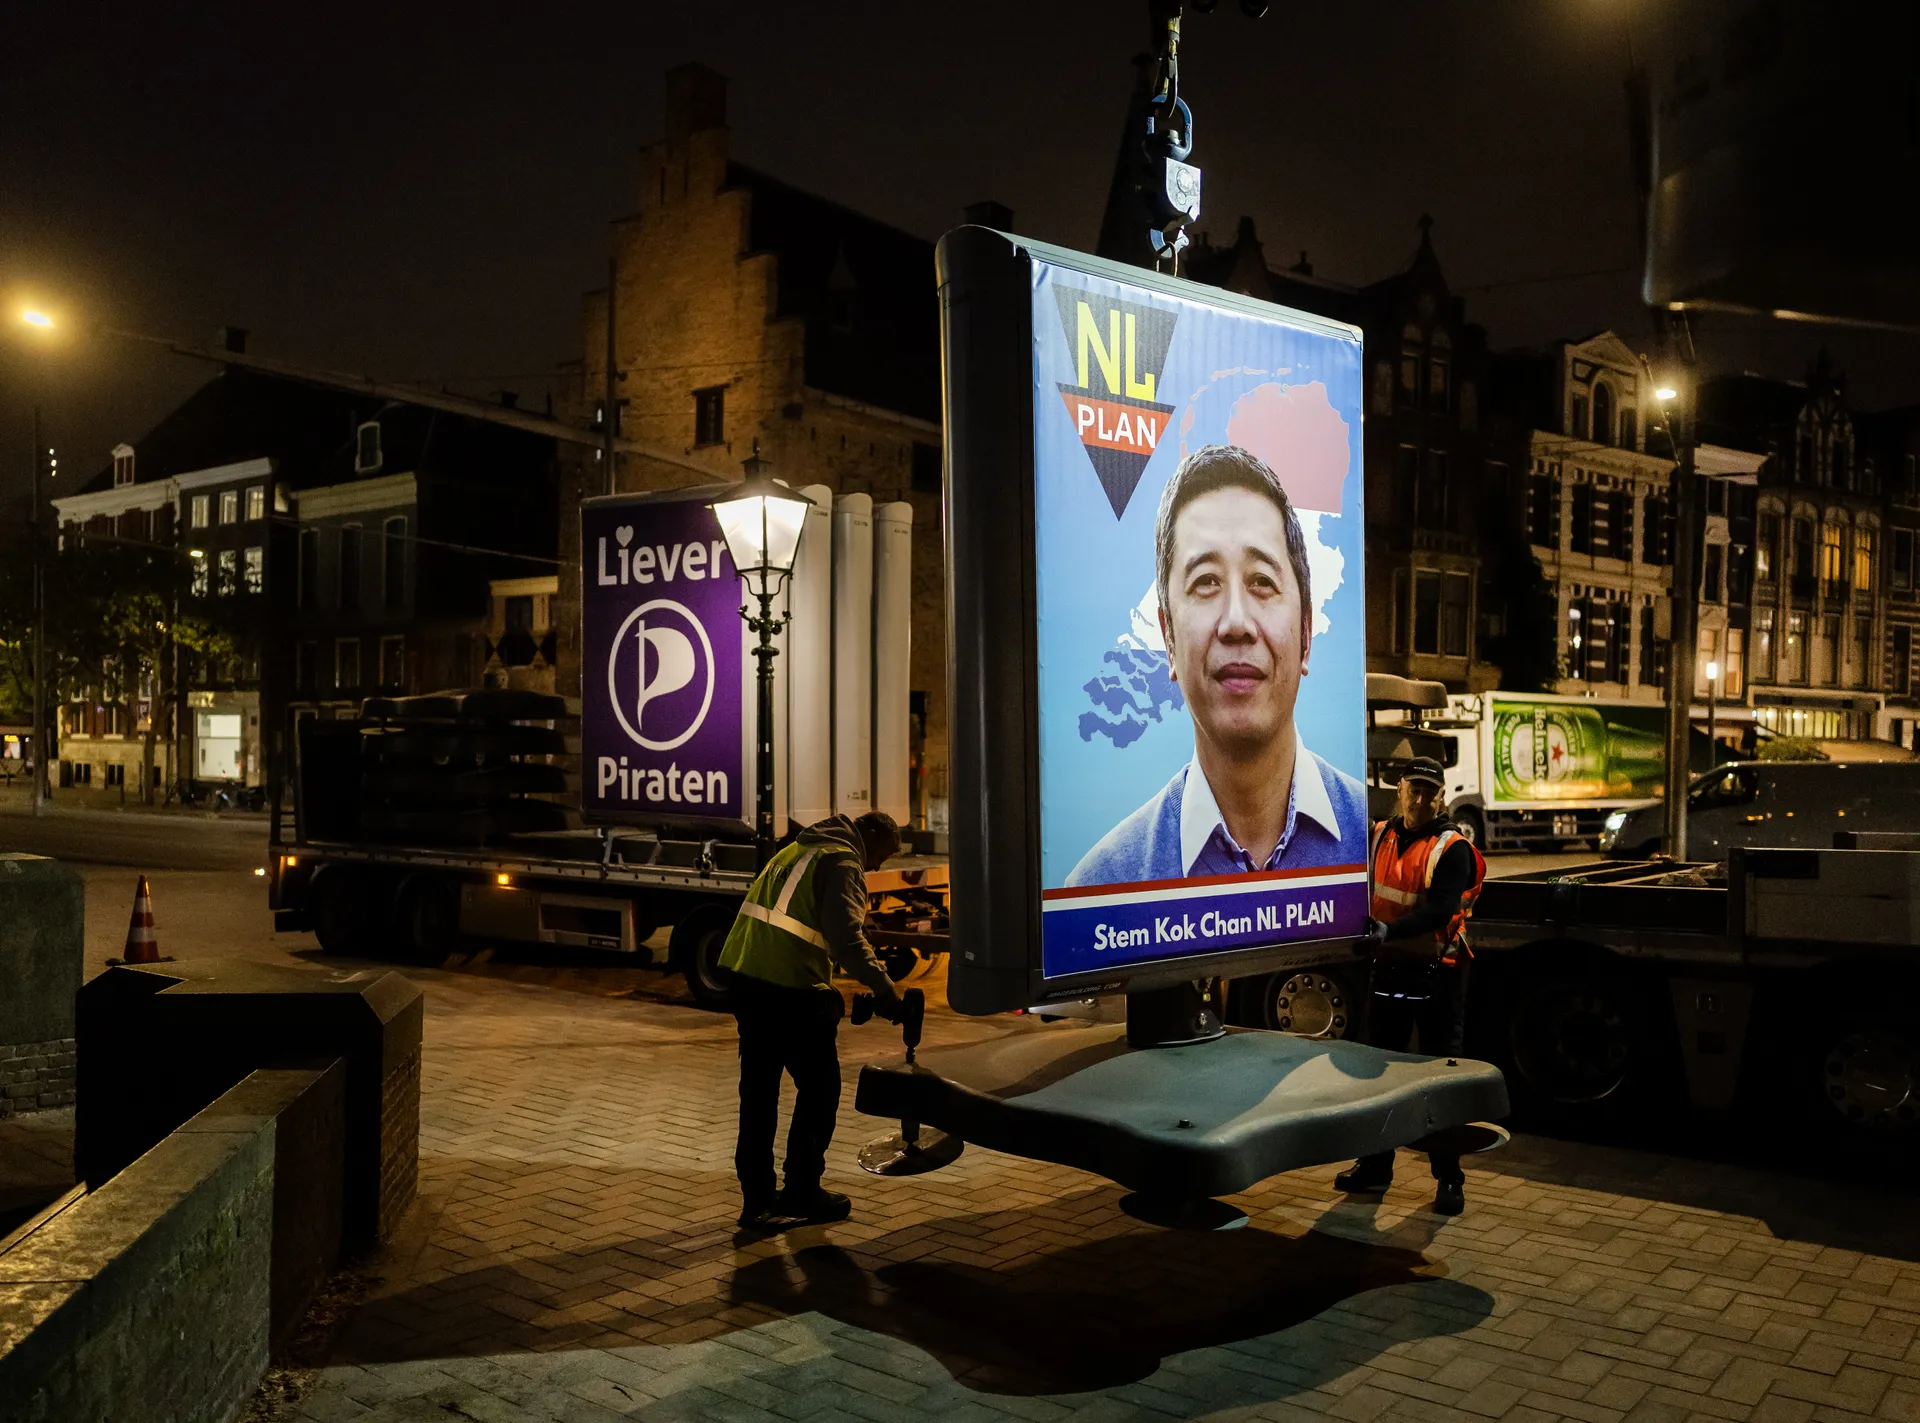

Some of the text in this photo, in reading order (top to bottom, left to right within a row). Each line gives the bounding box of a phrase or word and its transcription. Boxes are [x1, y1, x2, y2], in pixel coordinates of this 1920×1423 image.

[1077, 301, 1155, 402] NL
[1077, 403, 1157, 448] PLAN
[598, 525, 728, 586] Liever
[598, 756, 728, 804] Piraten
[1093, 900, 1334, 950] Stem Kok Chan NL PLAN
